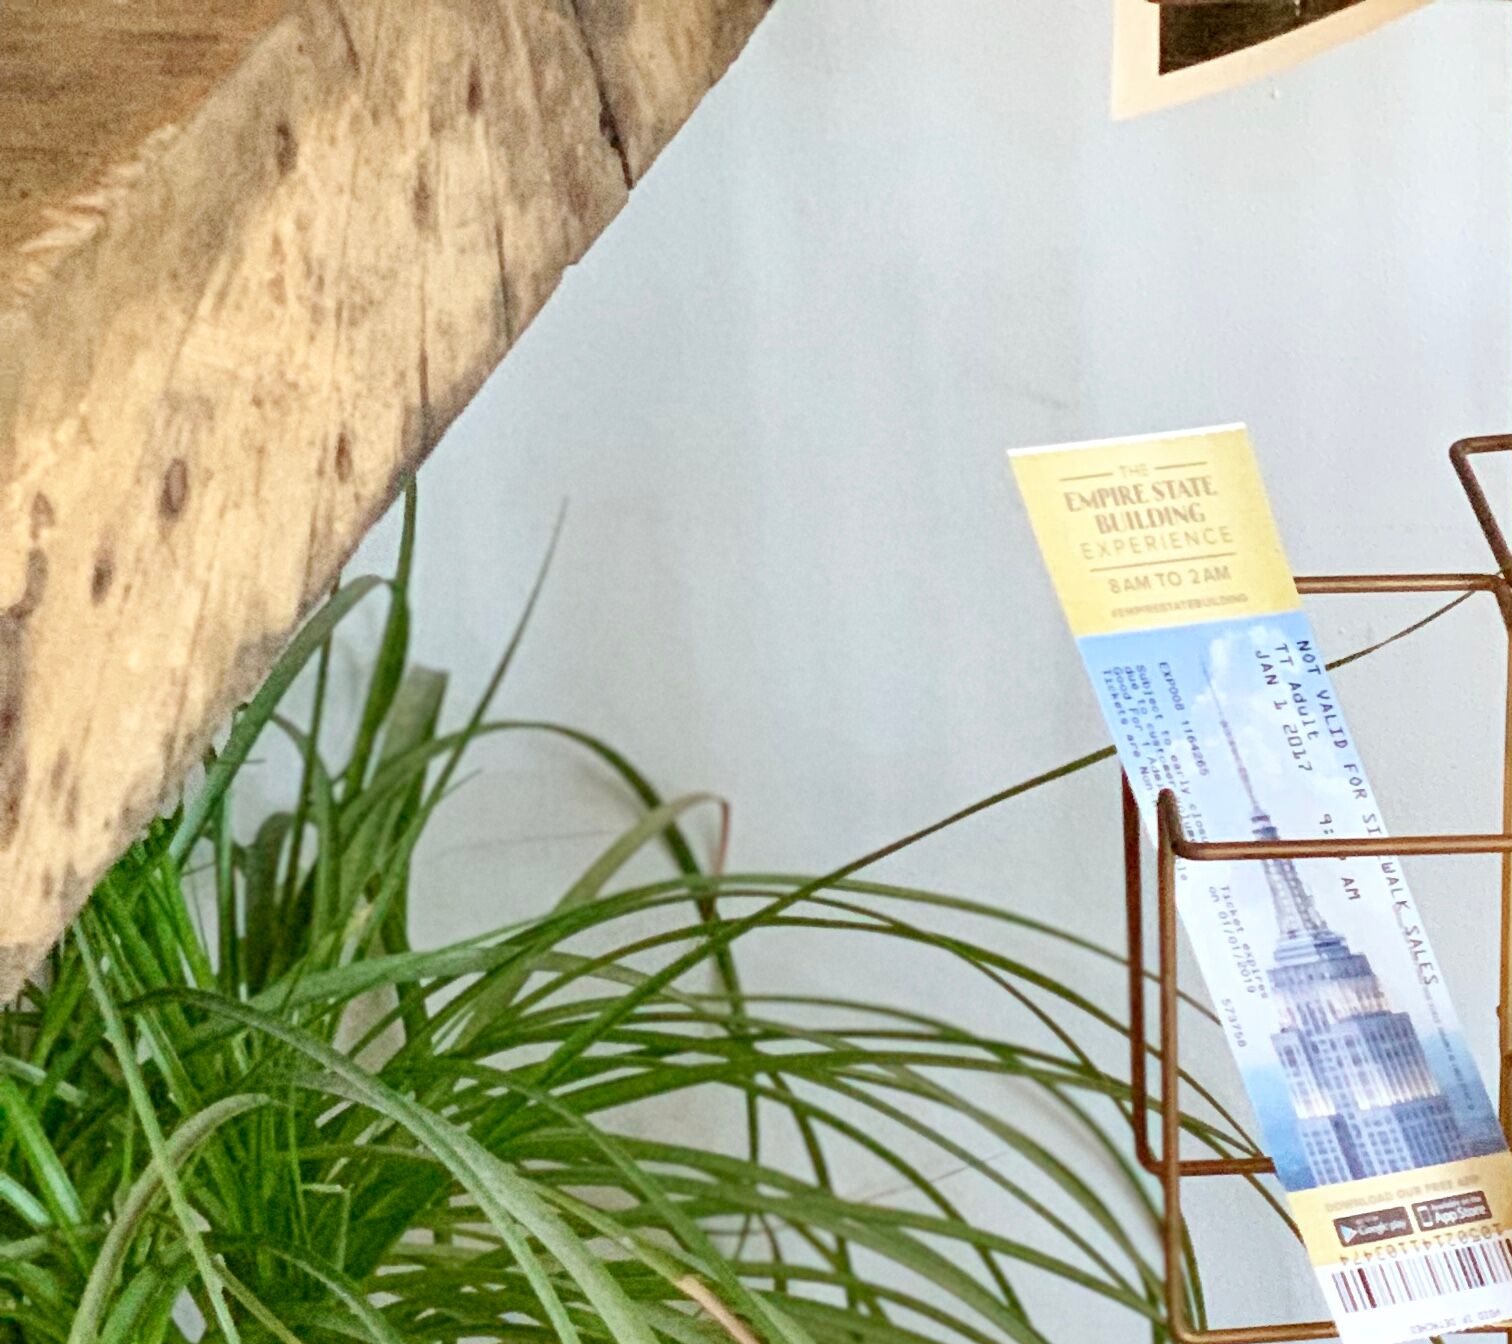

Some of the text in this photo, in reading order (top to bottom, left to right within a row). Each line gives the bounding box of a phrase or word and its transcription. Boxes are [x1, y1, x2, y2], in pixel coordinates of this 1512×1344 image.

[1116, 461, 1149, 478] THE
[1062, 475, 1218, 513] EMPIRE STATE
[1093, 502, 1206, 535] BUILDING
[1079, 525, 1236, 562] EXPERIENCE
[1153, 570, 1183, 587] TO
[1273, 642, 1319, 740] TT Adult
[1254, 649, 1278, 685] JAN
[1272, 699, 1288, 710] 1
[1281, 723, 1314, 772] 2017
[1339, 876, 1361, 900] AM
[1295, 639, 1439, 986] NOT VALID FOR SIWALK SALES
